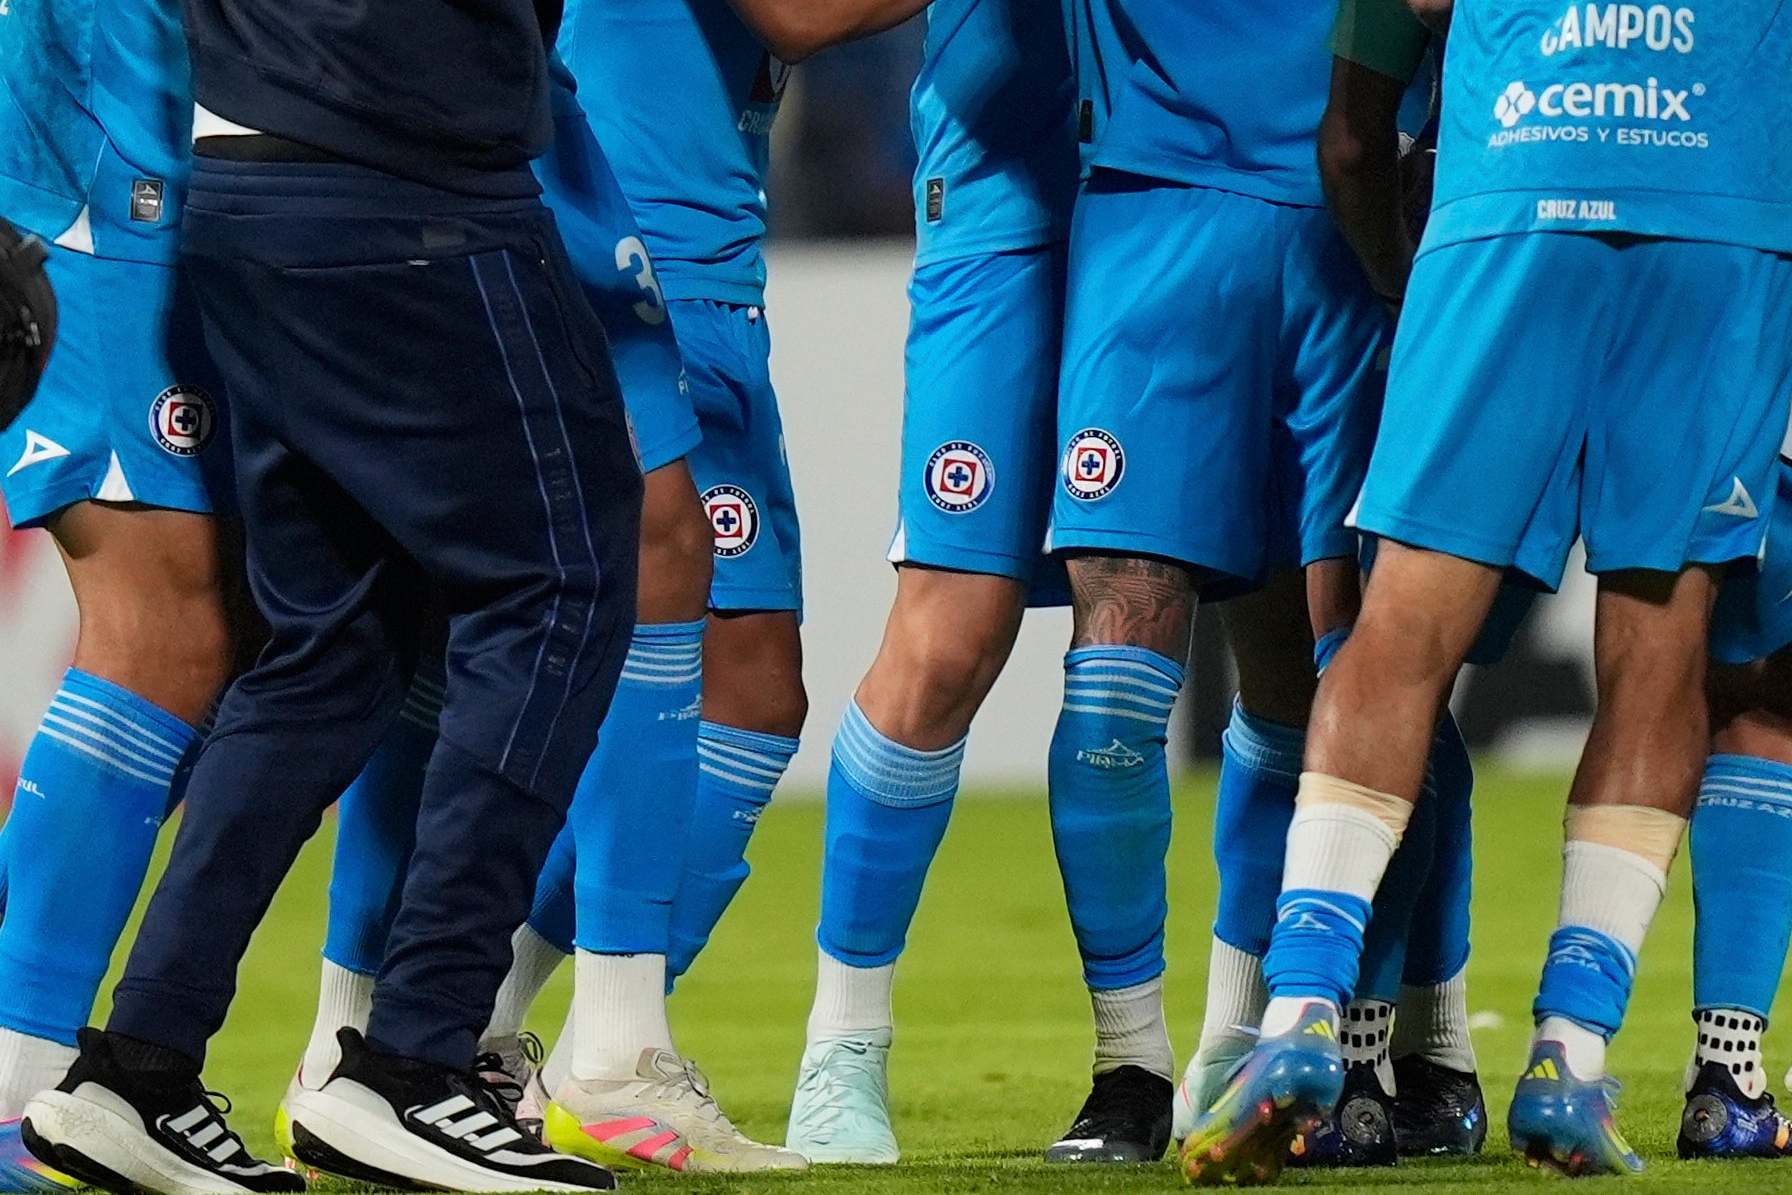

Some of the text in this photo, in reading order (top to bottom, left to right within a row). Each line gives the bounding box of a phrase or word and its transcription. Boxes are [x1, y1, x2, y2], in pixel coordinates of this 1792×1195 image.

[1540, 3, 1695, 56] CAMPOS
[1538, 77, 1691, 122] cemix
[1488, 125, 1709, 148] ADHESIVOS Y ESTUCOS
[1536, 199, 1617, 221] CRUZ AZUL
[615, 235, 666, 325] 3
